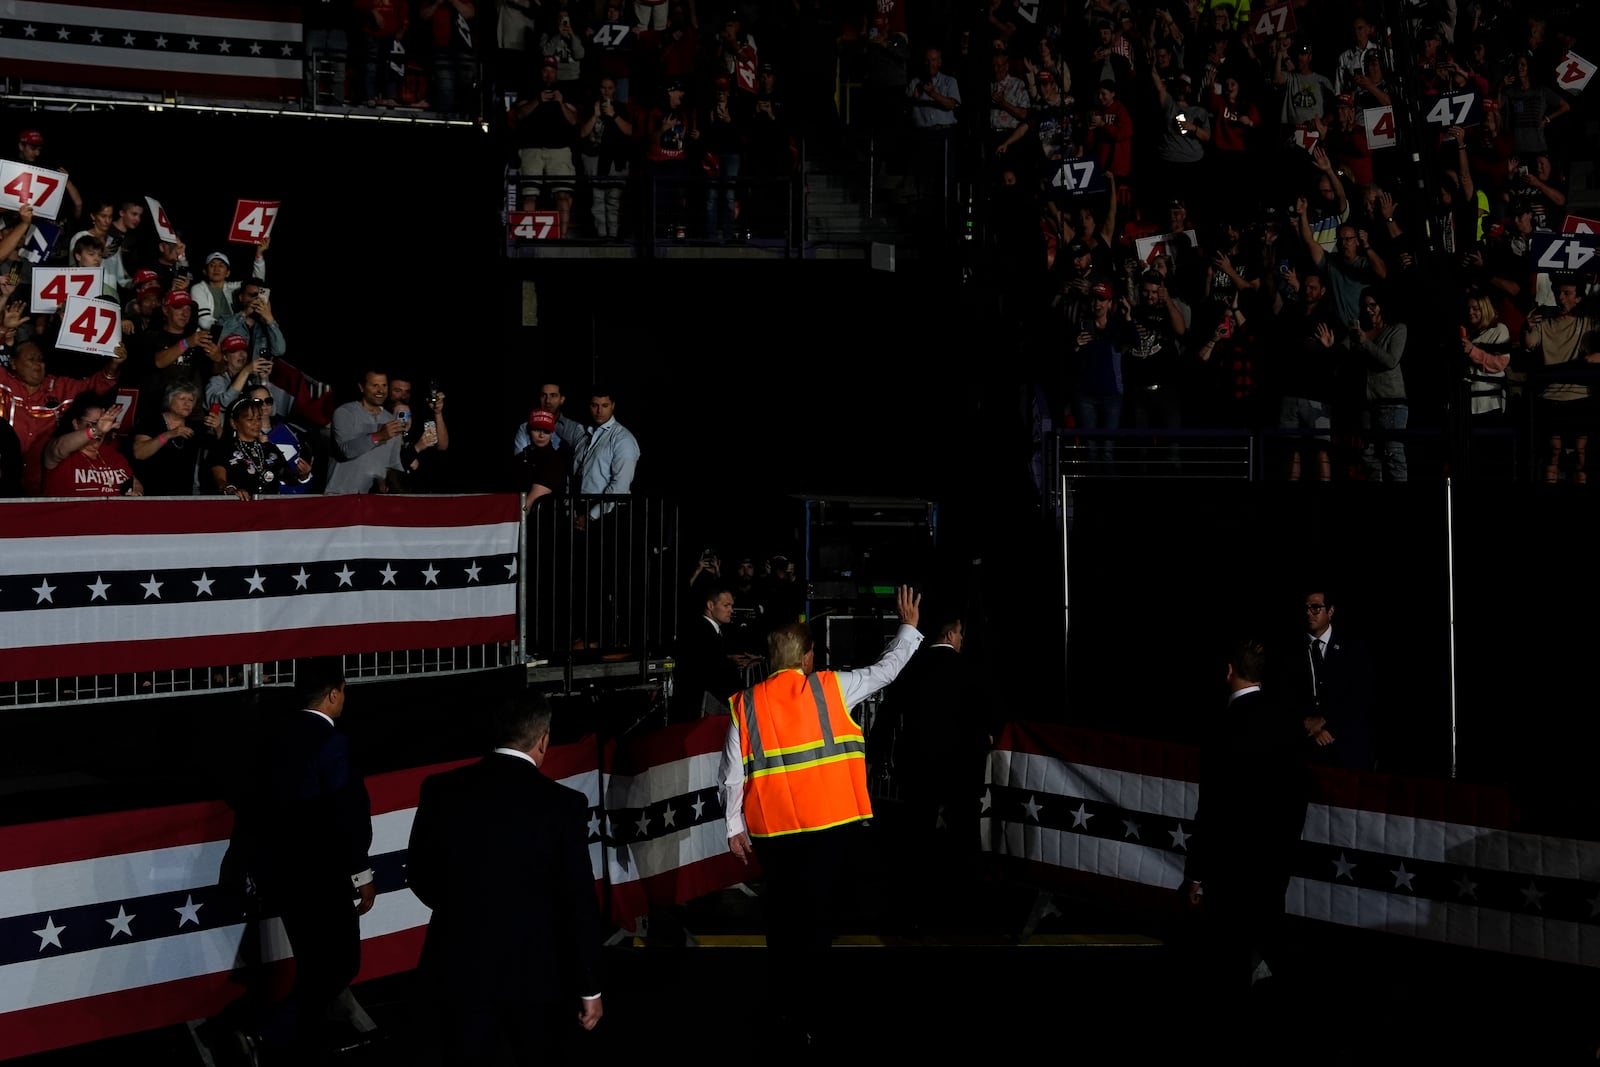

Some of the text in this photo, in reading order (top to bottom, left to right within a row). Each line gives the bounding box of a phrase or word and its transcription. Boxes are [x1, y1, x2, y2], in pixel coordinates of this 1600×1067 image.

[593, 24, 630, 47] 47
[1255, 6, 1289, 35] 47
[390, 39, 406, 77] 47
[1426, 93, 1475, 127] 47
[4, 172, 59, 207] 47
[1051, 161, 1095, 190] 47
[238, 207, 279, 238] 47
[514, 215, 555, 239] 47
[1537, 239, 1596, 269] 47
[40, 274, 94, 305] 47
[69, 306, 117, 344] 47
[74, 467, 131, 486] NATIVES
